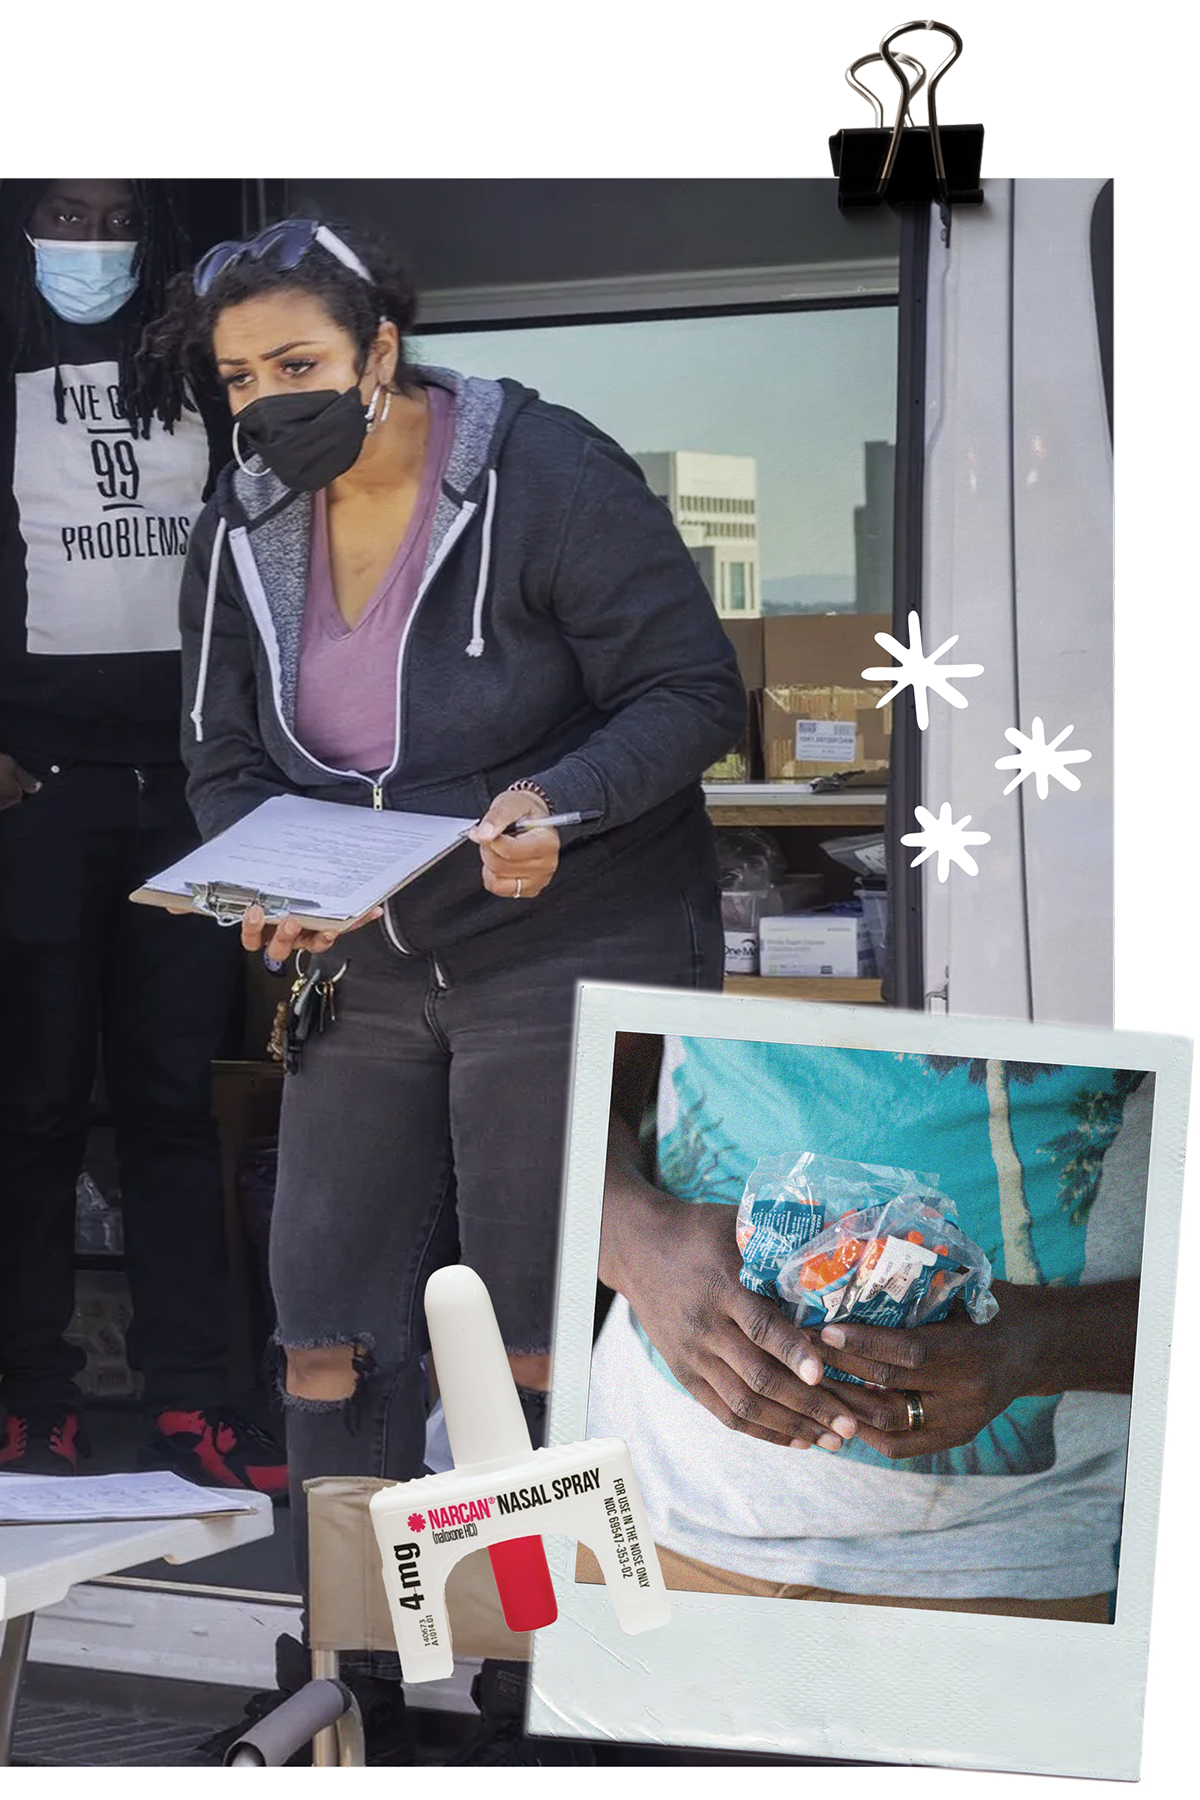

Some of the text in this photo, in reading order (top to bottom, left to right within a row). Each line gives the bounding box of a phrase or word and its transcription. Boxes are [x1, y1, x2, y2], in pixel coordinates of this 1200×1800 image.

[60, 384, 102, 421] 'VE
[91, 440, 139, 500] 99
[62, 516, 190, 562] PROBLEMS
[497, 1484, 552, 1515] NASAL
[552, 1467, 601, 1501] SPRAY
[603, 1497, 634, 1579] NDC 69547-353-02
[612, 1477, 650, 1589] FOR USE IN THE NOSE ONLY
[393, 1542, 425, 1610] 4 mg
[419, 1618, 431, 1647] 140673
